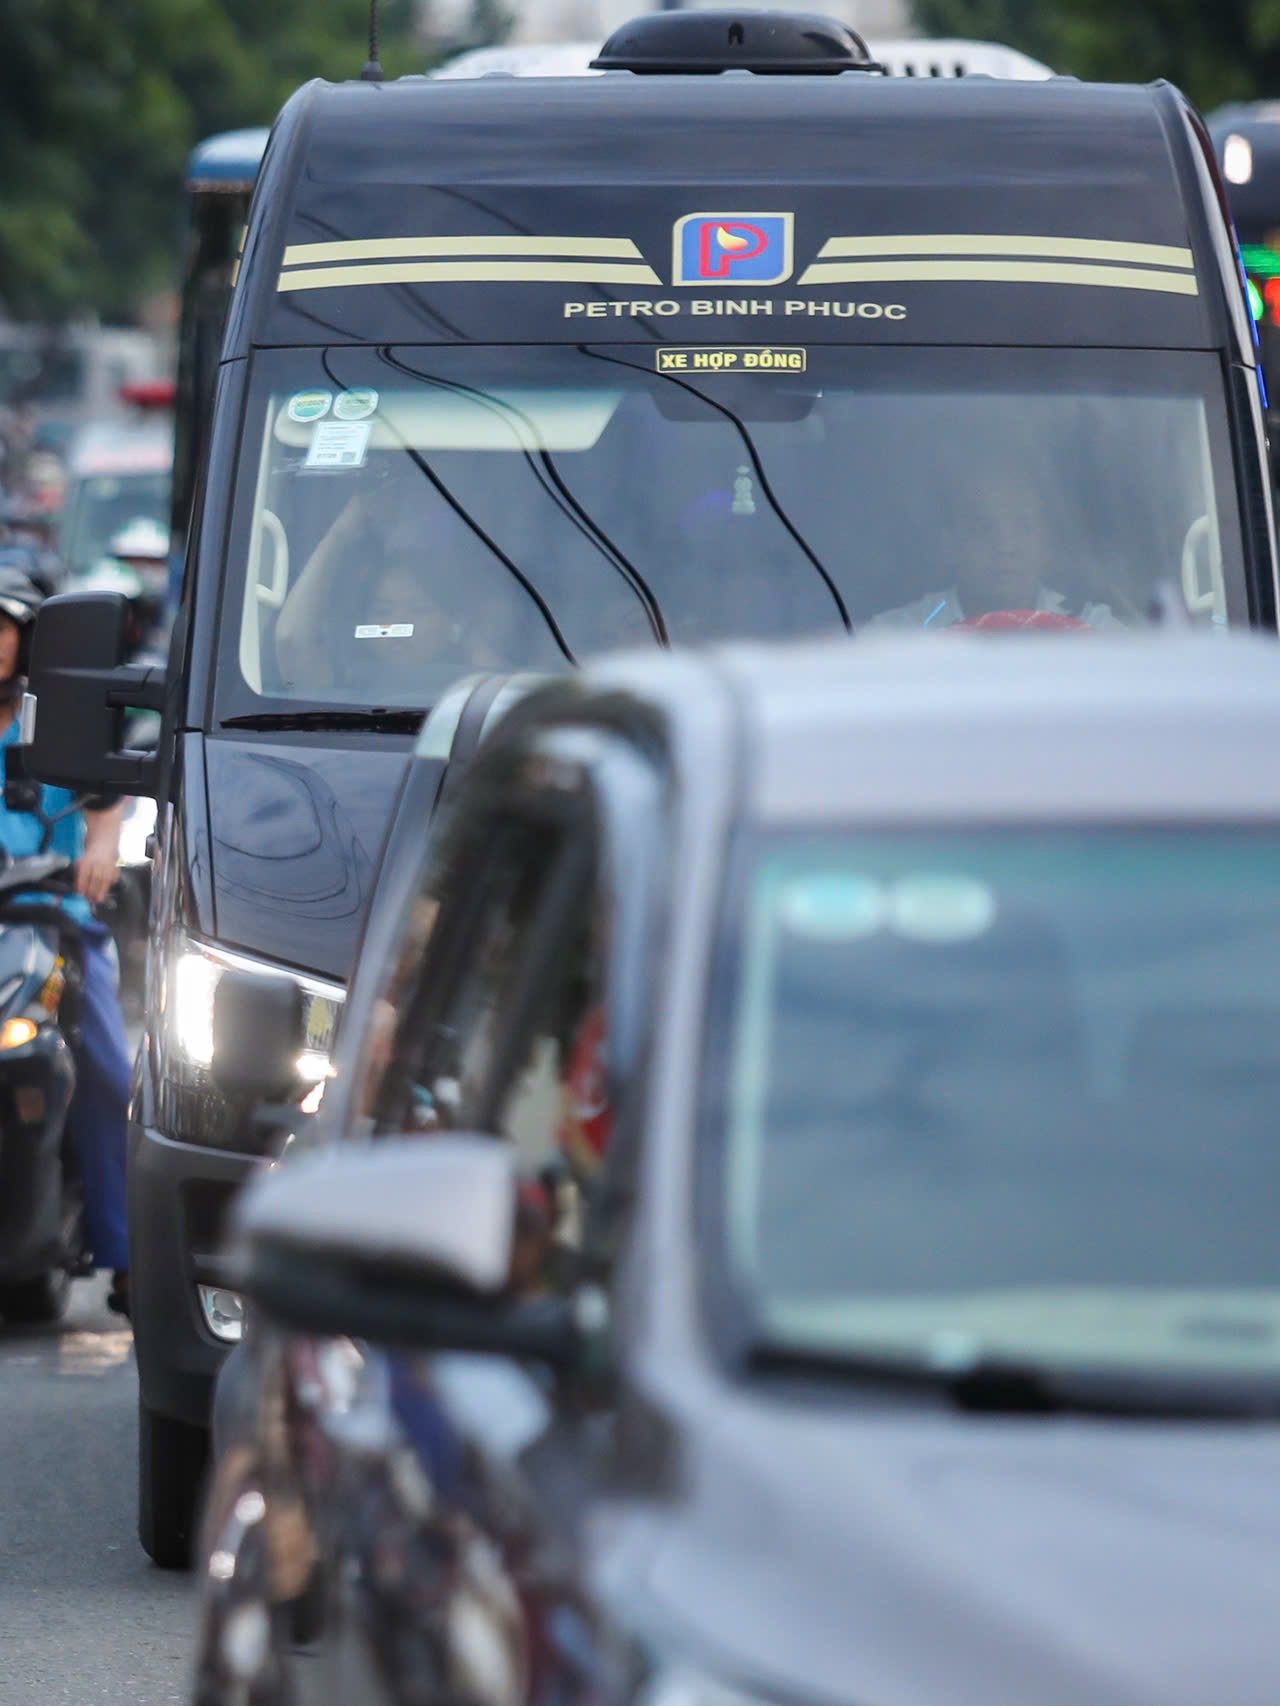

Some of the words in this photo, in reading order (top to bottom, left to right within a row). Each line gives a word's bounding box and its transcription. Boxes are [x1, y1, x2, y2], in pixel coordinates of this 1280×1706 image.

[563, 300, 680, 318] PETRO
[691, 300, 773, 316] BINH
[785, 300, 907, 320] PHUOC
[661, 353, 688, 369] XE
[693, 351, 738, 370] HỢP
[742, 349, 802, 369] ĐỒNG
